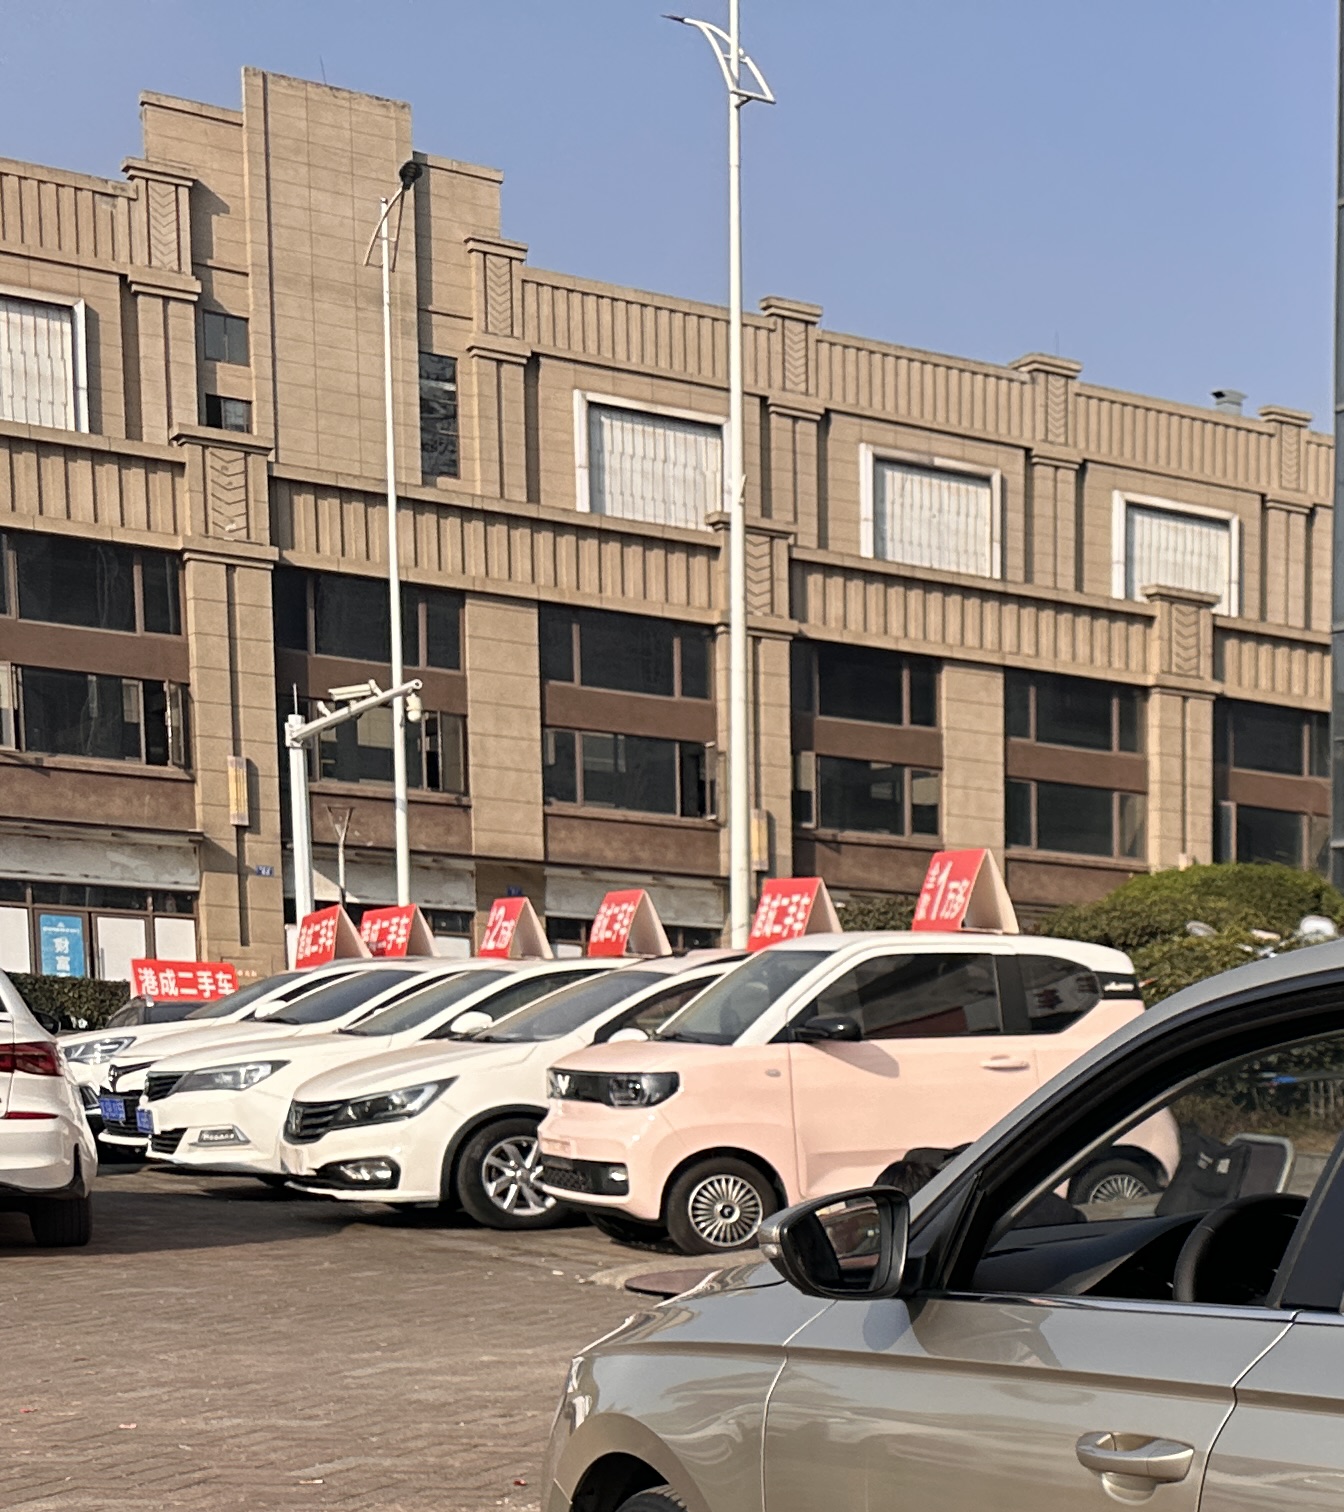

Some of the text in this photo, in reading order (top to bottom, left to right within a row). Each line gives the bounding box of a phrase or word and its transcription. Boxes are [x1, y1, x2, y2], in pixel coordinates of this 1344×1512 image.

[137, 966, 236, 999] 港成二手车
